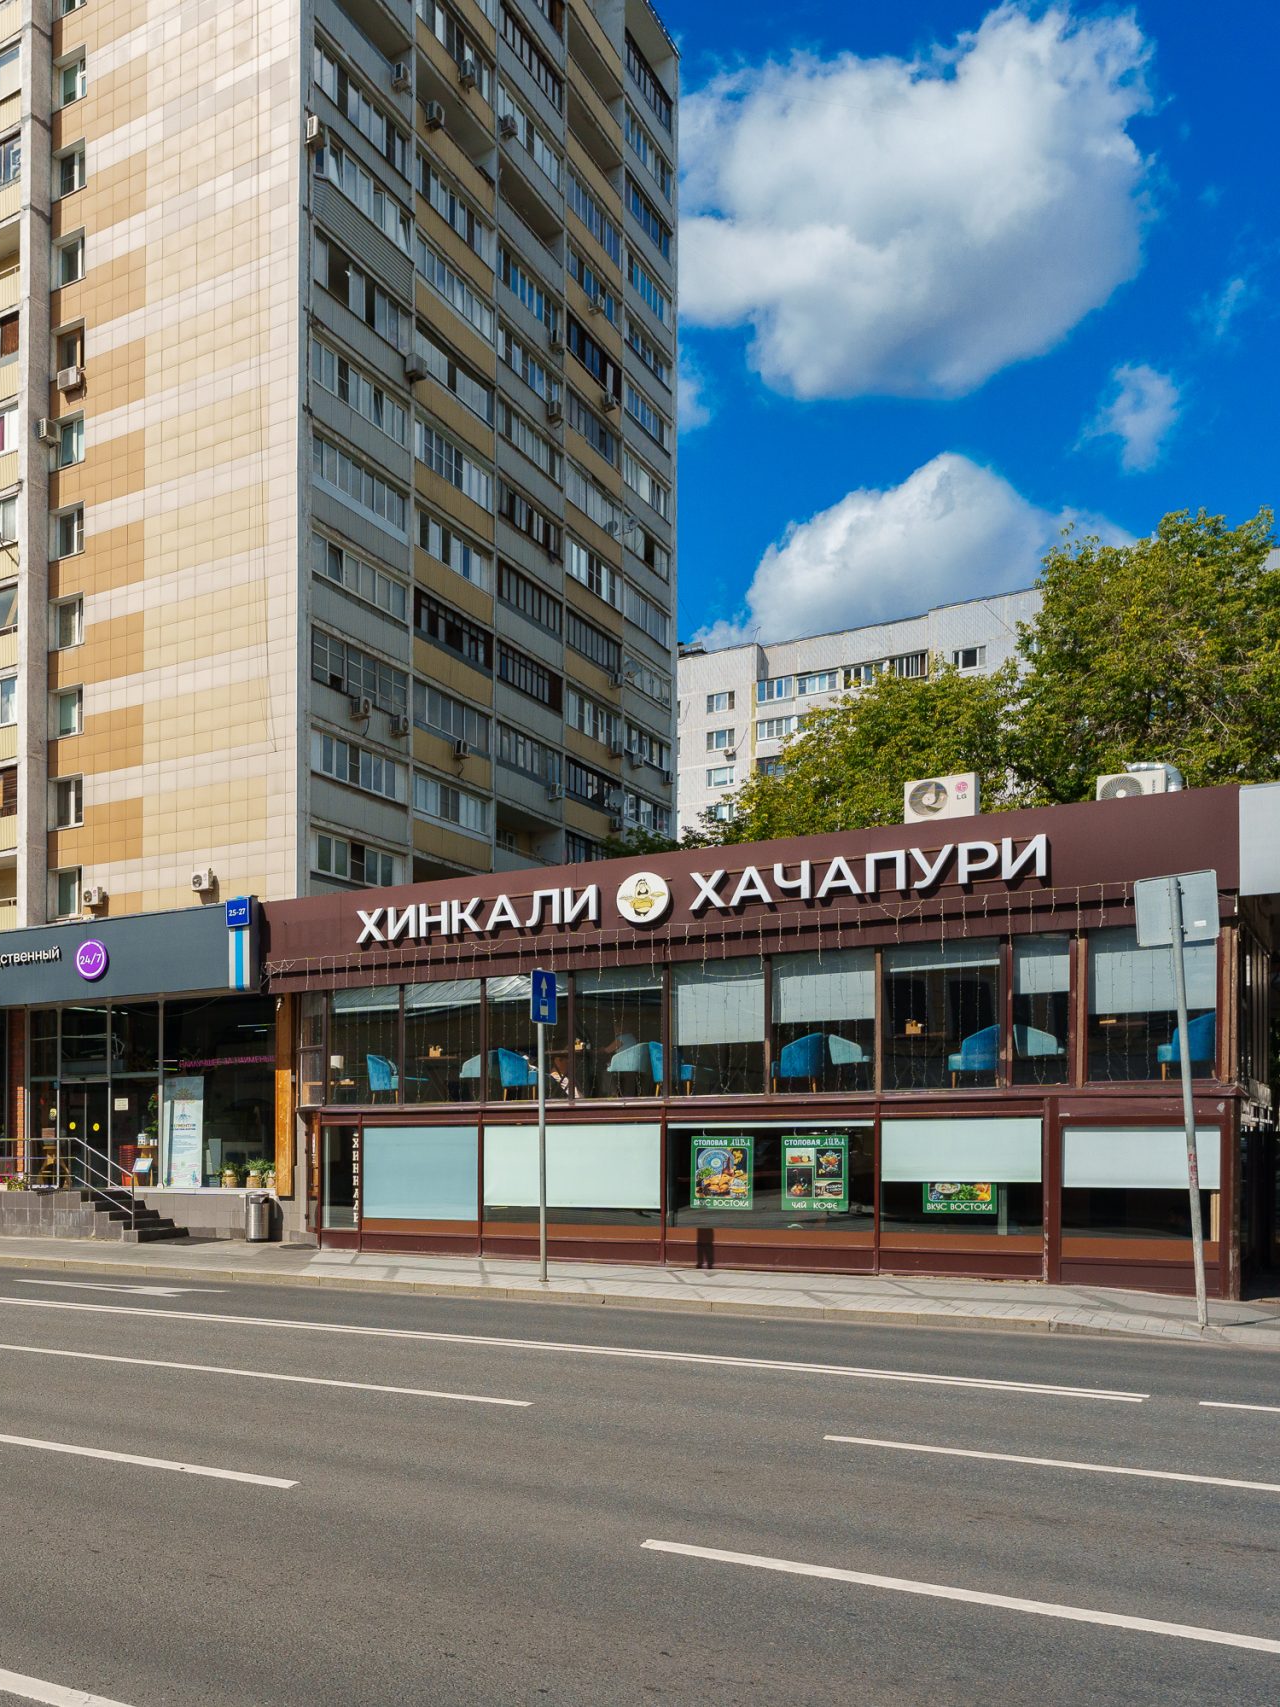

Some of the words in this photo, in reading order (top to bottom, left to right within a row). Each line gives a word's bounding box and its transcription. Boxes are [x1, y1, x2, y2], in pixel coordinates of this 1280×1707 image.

[356, 884, 599, 944] ХИНКАЛИ
[689, 833, 1047, 911] ХАЧАПУРИ
[228, 907, 246, 917] 25-27
[79, 953, 102, 965] 24/7
[693, 1138, 728, 1147] СТОЛОВАЯ
[784, 1138, 821, 1147] СТОЛОВАЯ
[693, 1198, 712, 1207] ВКУС
[713, 1199, 749, 1208] ВОСТОКА
[791, 1200, 807, 1209] ЧАЙ
[813, 1200, 838, 1209] КОФЕ
[926, 1202, 947, 1211] ВКУС
[950, 1202, 993, 1211] ВОСТОКА
